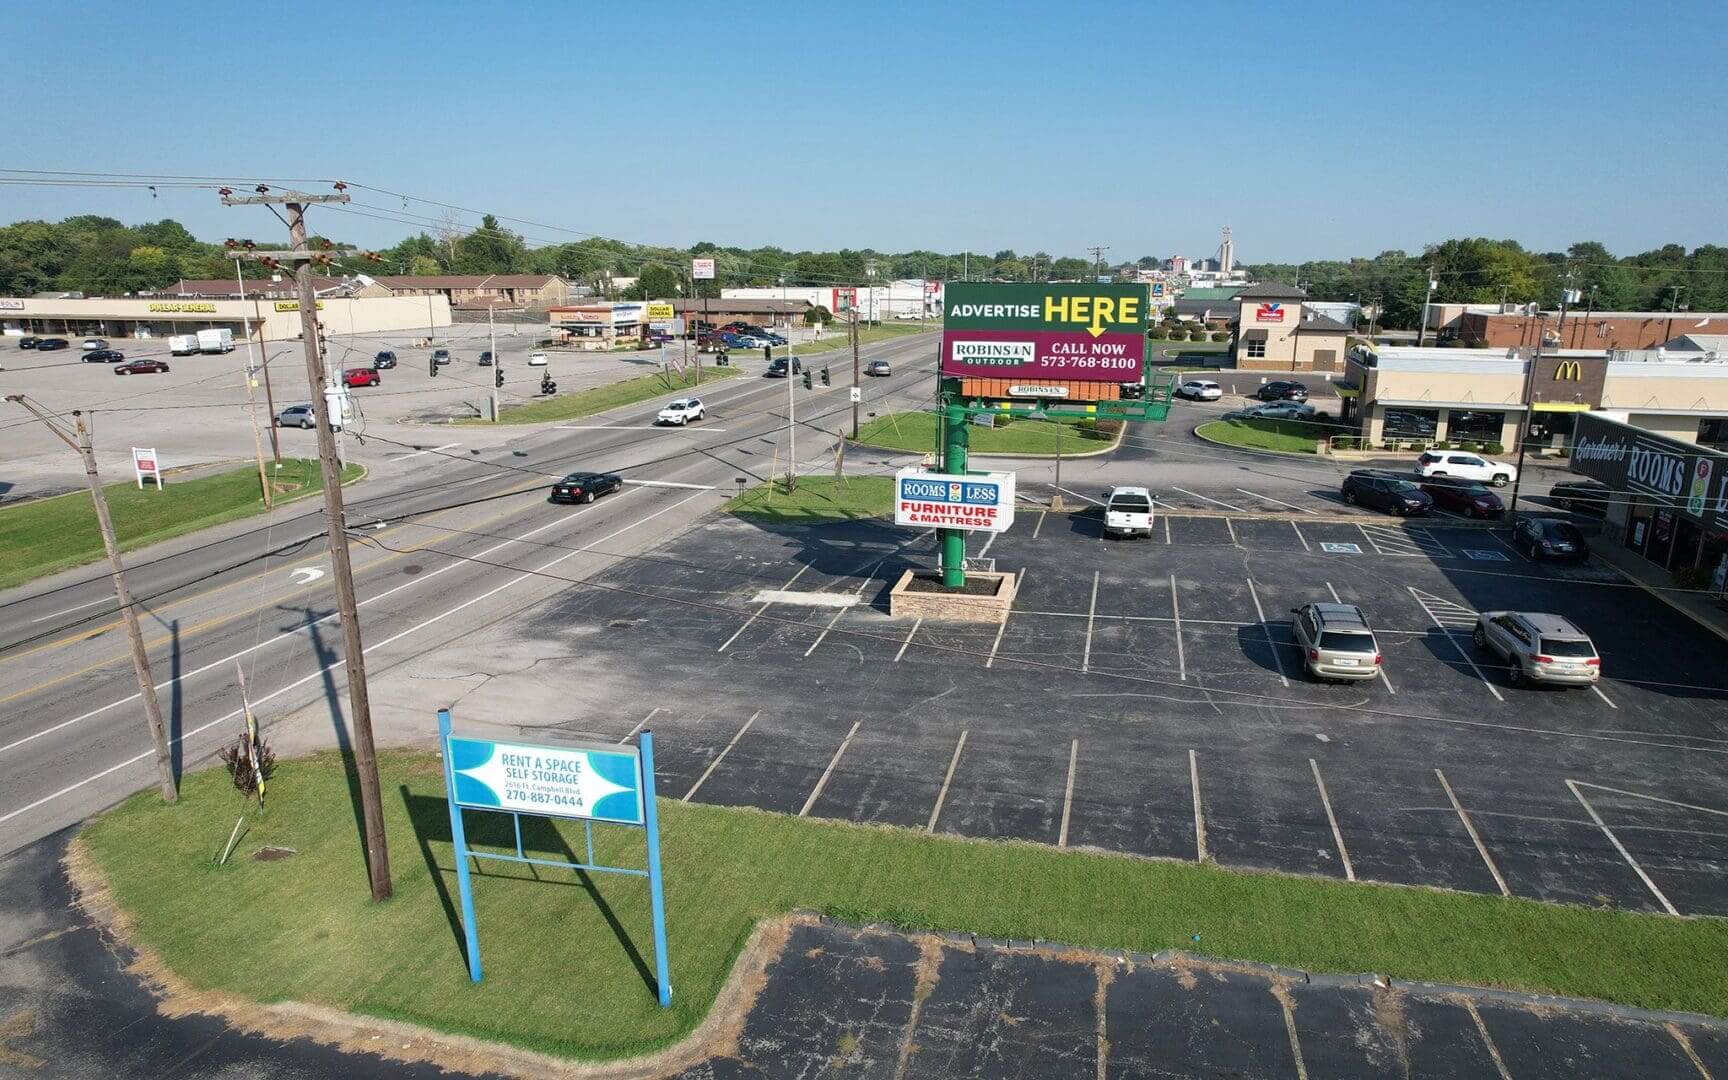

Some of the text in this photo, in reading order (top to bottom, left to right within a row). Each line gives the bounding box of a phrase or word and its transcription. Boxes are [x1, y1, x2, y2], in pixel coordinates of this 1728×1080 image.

[951, 297, 1139, 323] ADVERTISE HERE
[956, 344, 1032, 356] ROBINSON
[1052, 342, 1126, 355] CALL NOW
[1041, 356, 1136, 370] 573-768-8100
[1017, 386, 1061, 394] ROBINSON
[1576, 435, 1627, 463] Gardner's
[1628, 446, 1686, 496] ROOMS
[904, 483, 946, 497] ROOMS
[966, 487, 996, 500] LESS
[901, 502, 998, 518] FURNITURE
[909, 513, 992, 527] & MATTRESS
[502, 753, 581, 773] RENT A SPACE
[506, 767, 579, 785] SELF STORAGE
[532, 783, 564, 793] Campbell
[506, 789, 584, 807] 270-887-0444
